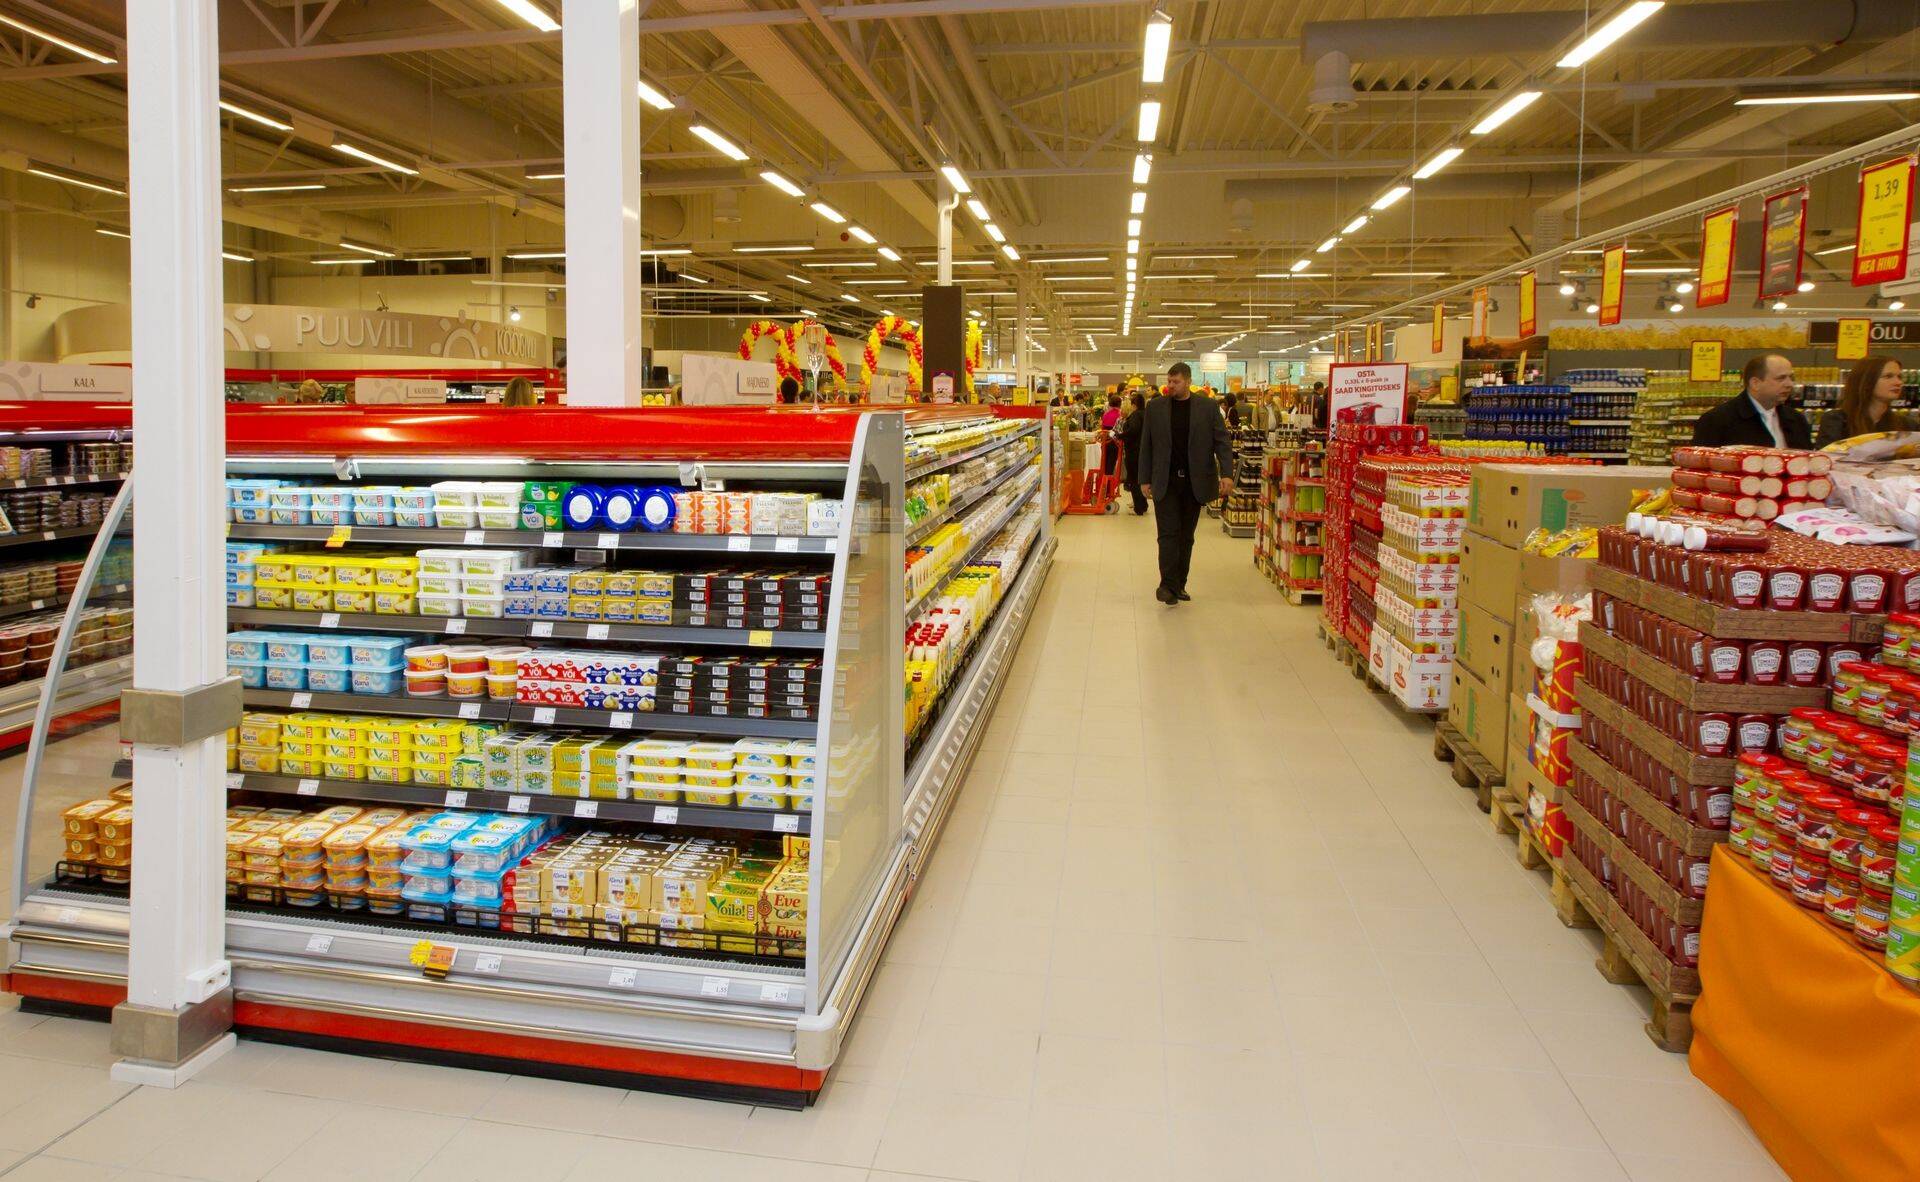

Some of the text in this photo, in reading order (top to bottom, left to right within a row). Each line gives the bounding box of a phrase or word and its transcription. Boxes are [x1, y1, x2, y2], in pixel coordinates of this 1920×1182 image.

[297, 314, 413, 348] PUUVILI
[1871, 324, 1906, 340] ÕLU
[1357, 370, 1376, 378] OSTA
[74, 377, 95, 388] KALA
[1334, 384, 1401, 394] SAAD KINGITUSEKS
[529, 666, 542, 676] VÕI
[562, 668, 576, 678] VÕI
[528, 690, 541, 700] VÕI
[561, 692, 574, 702] VÕI
[553, 872, 567, 880] Rama
[608, 876, 623, 885] Rama
[664, 882, 679, 891] Rama
[774, 894, 801, 907] Eve
[709, 896, 746, 917] Voila!
[775, 925, 801, 940] Eve
